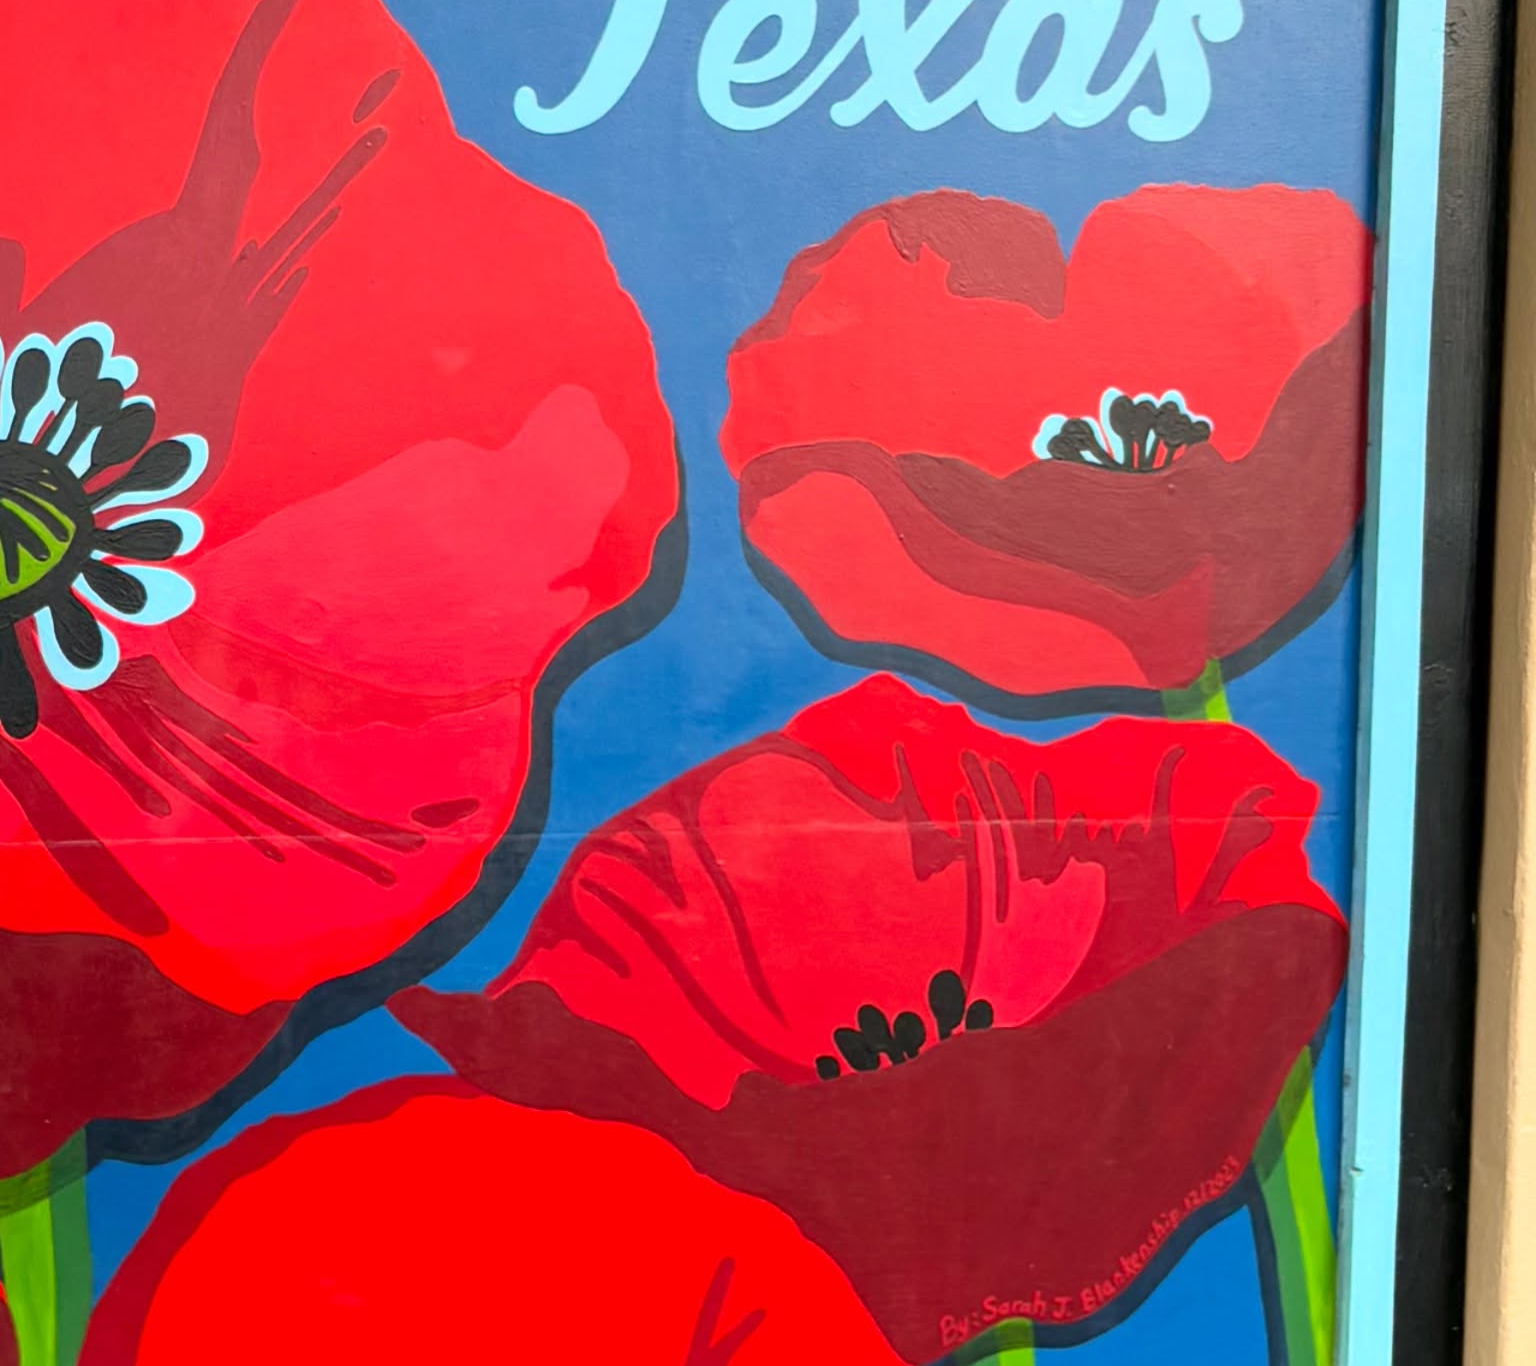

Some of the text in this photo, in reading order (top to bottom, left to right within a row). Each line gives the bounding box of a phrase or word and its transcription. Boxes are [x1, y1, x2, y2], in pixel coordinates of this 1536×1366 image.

[982, 1290, 1047, 1322] Sarah
[1051, 1296, 1072, 1321] J.
[1080, 1207, 1180, 1315] Blankenship
